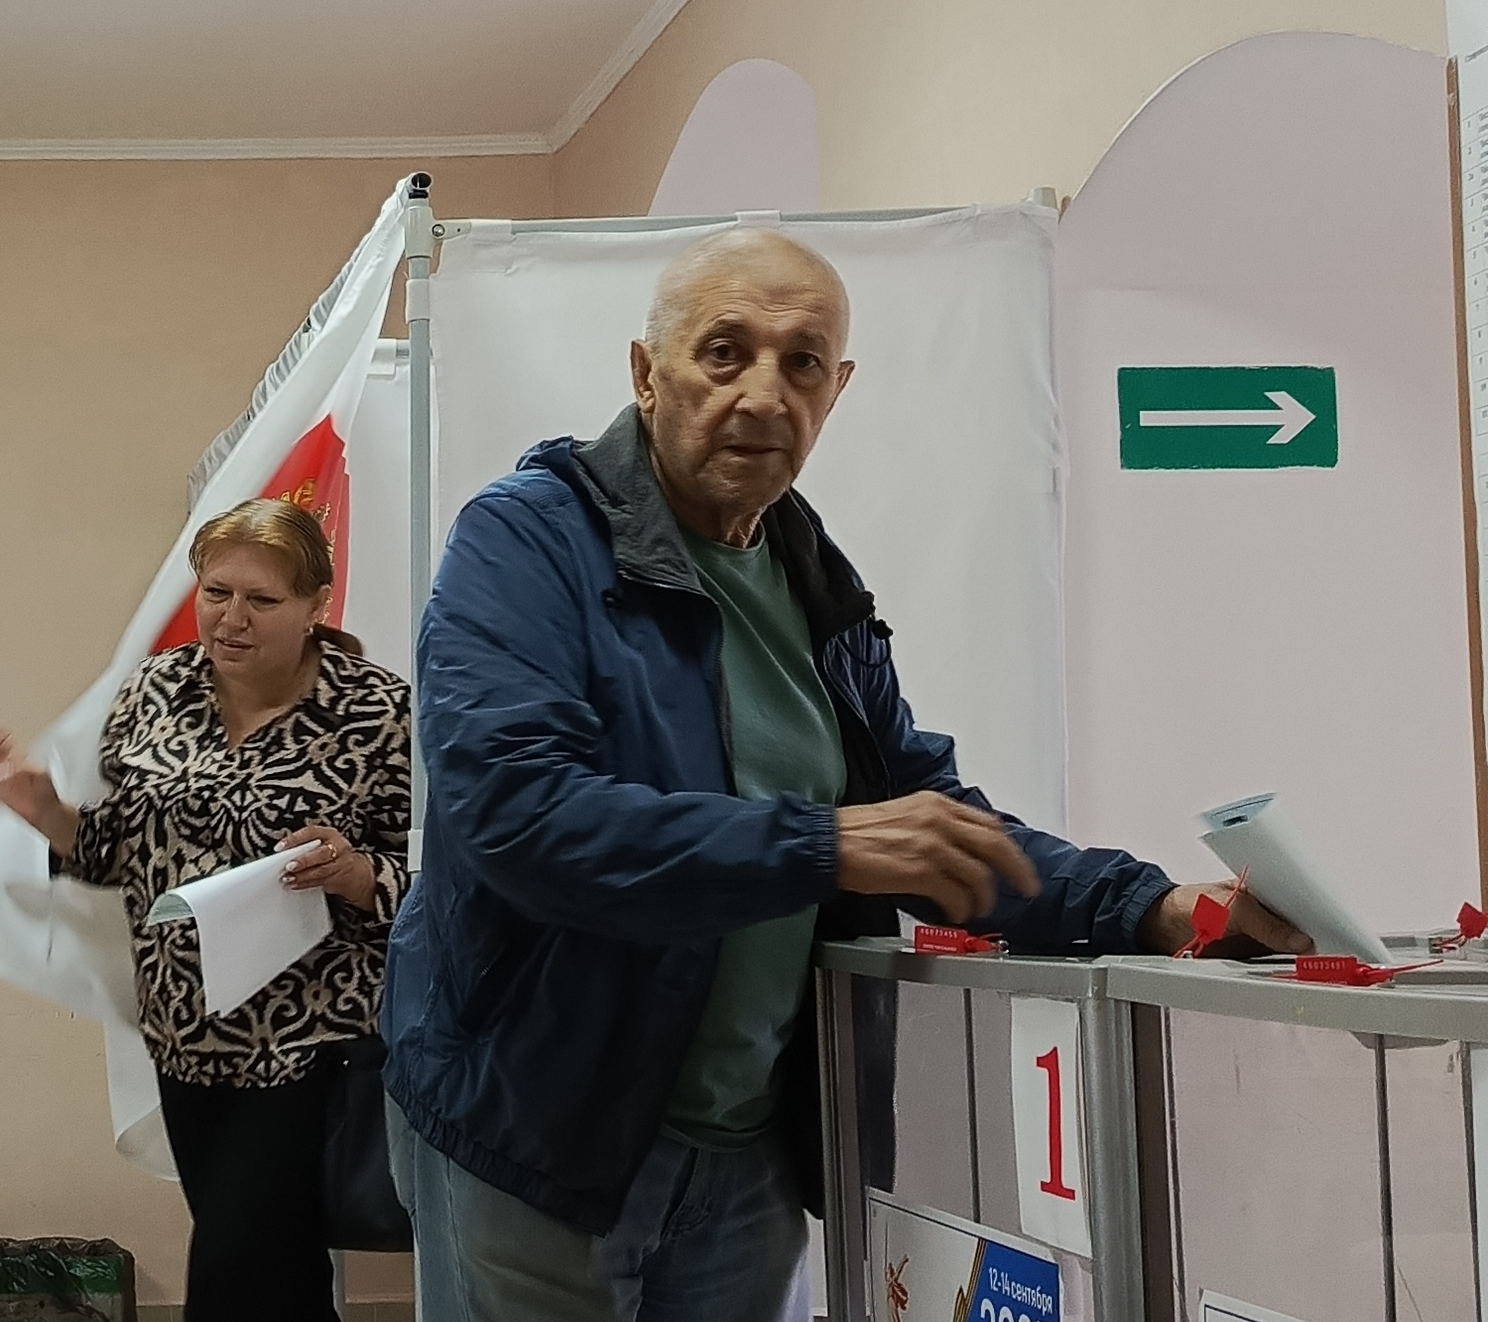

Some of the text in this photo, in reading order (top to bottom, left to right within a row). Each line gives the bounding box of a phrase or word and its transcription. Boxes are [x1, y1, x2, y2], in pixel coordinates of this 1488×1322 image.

[1036, 1046, 1075, 1201] 1
[988, 1267, 1053, 1316] 12-14 сентября
